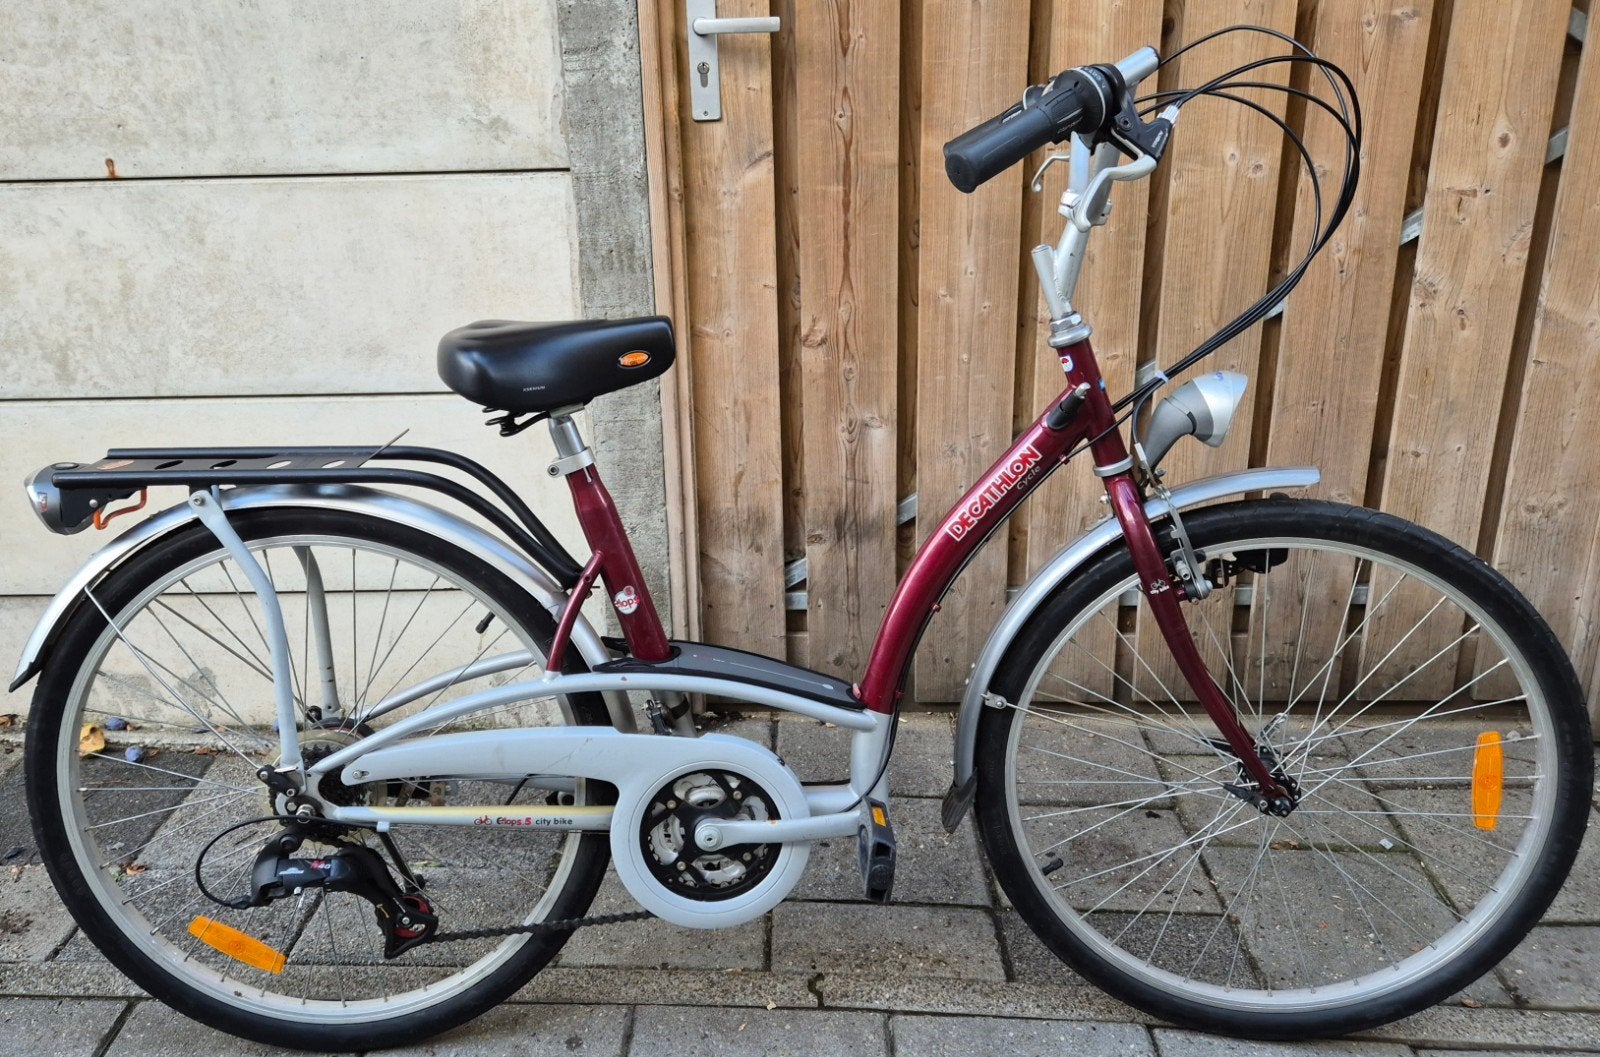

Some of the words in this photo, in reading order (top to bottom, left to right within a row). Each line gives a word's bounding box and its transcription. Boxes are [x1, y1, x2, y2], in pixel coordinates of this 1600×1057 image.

[1016, 465, 1041, 491] Cycle
[944, 443, 1043, 542] DECATHLON
[535, 817, 551, 827] city
[553, 817, 573, 826] bike
